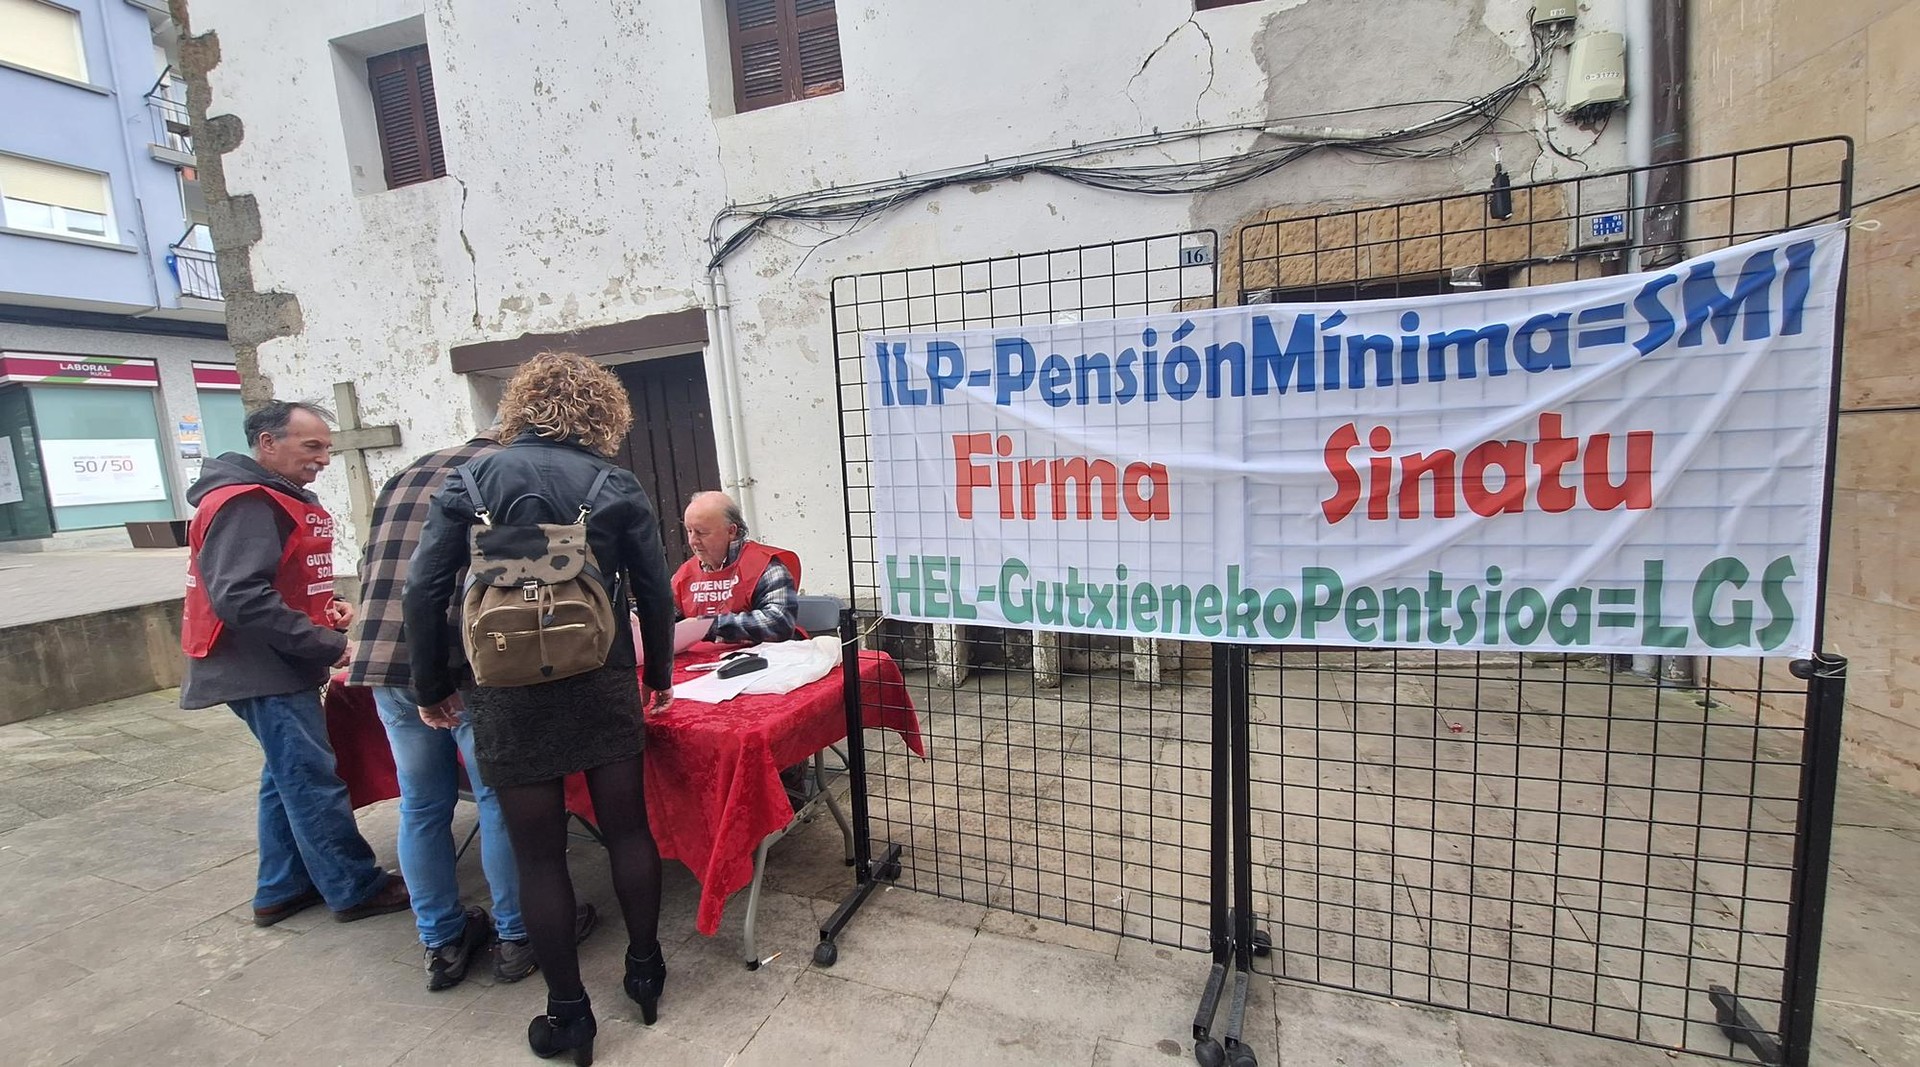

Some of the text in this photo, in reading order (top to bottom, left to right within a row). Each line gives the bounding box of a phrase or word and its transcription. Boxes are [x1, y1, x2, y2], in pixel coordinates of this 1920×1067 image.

[1186, 249, 1203, 263] 16
[60, 363, 111, 372] LABORAL
[875, 240, 1815, 407] ILP-PensiónMínima=SMI
[953, 412, 1654, 525] Firma Sinatu
[886, 556, 1796, 652] HEL-GutxienekoPentsioa=LGS
